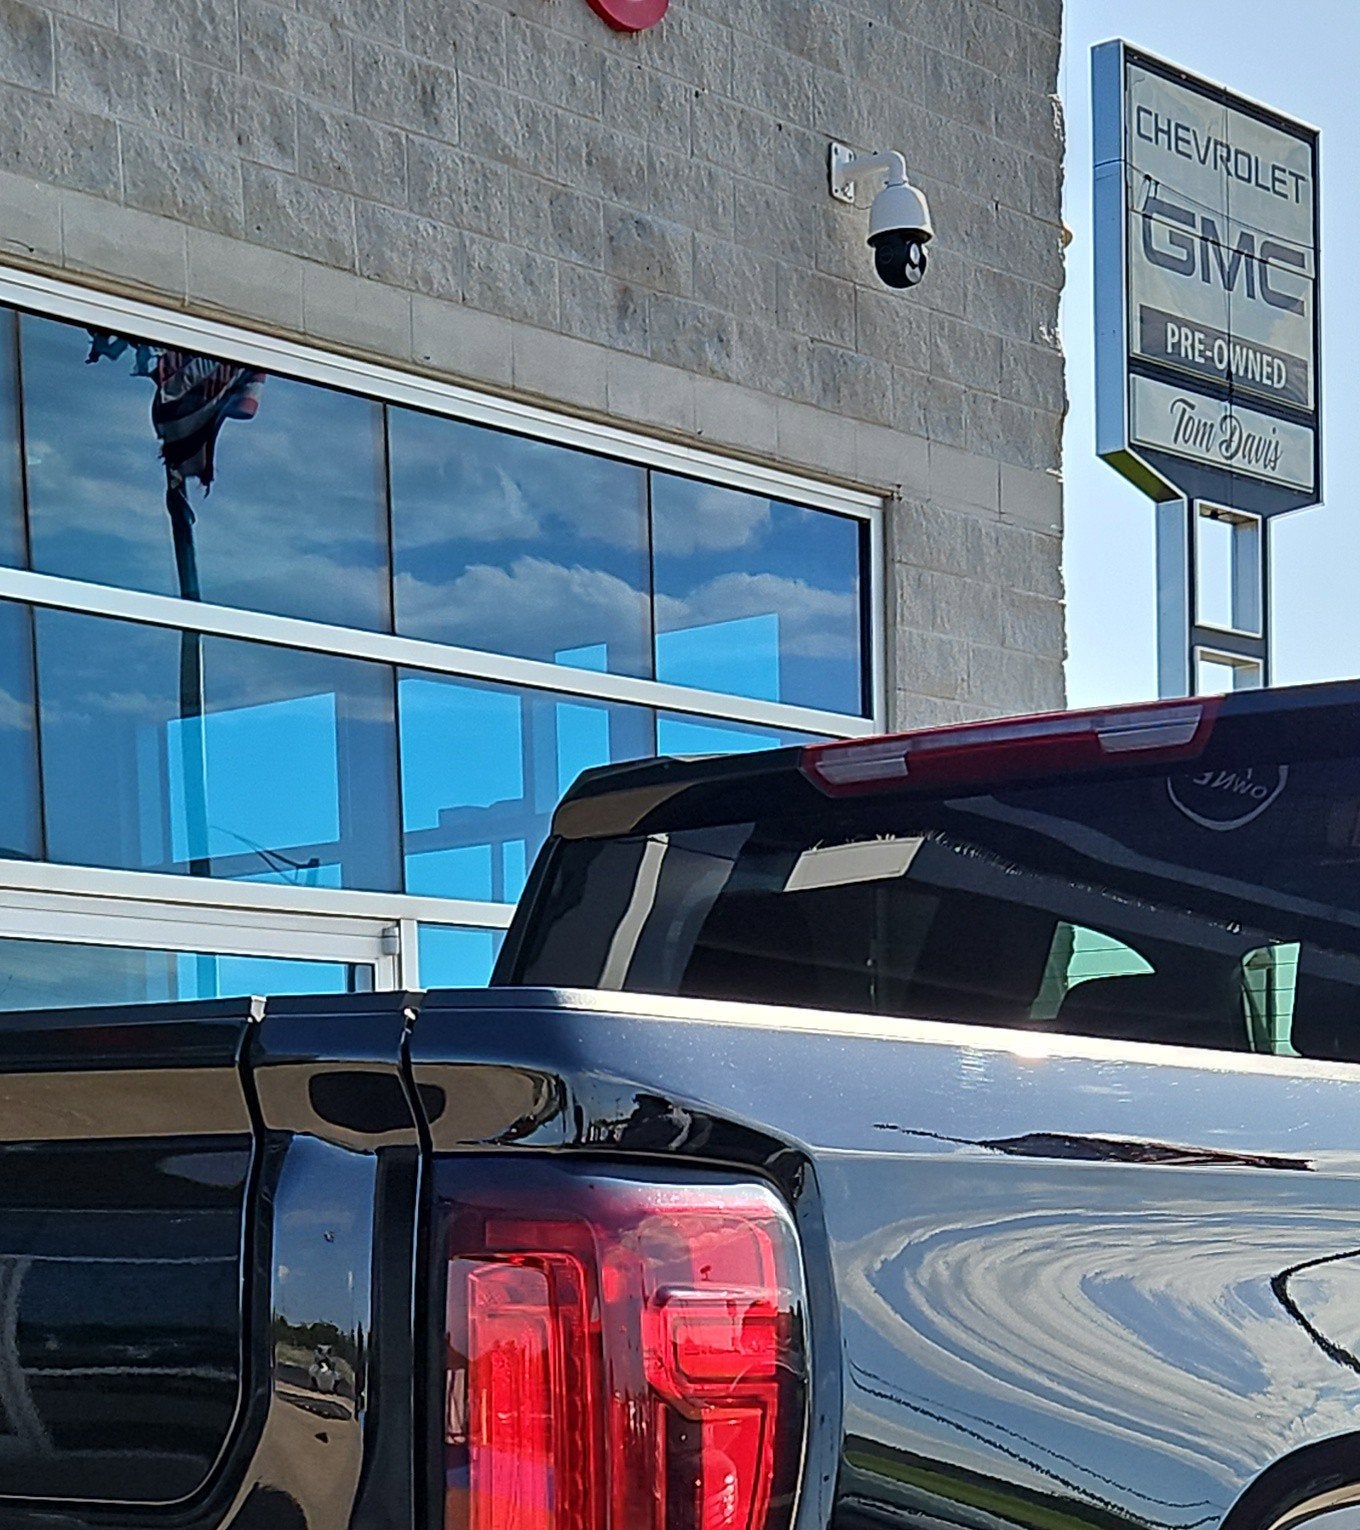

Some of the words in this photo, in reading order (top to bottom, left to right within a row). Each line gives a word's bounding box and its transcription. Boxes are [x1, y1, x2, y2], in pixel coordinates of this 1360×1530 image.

[1136, 105, 1307, 204] CHEVROLET
[1142, 196, 1306, 317] GMC
[1166, 322, 1287, 389] PRE-OWNED
[1170, 397, 1215, 453] Tom
[1218, 414, 1283, 472] Davis
